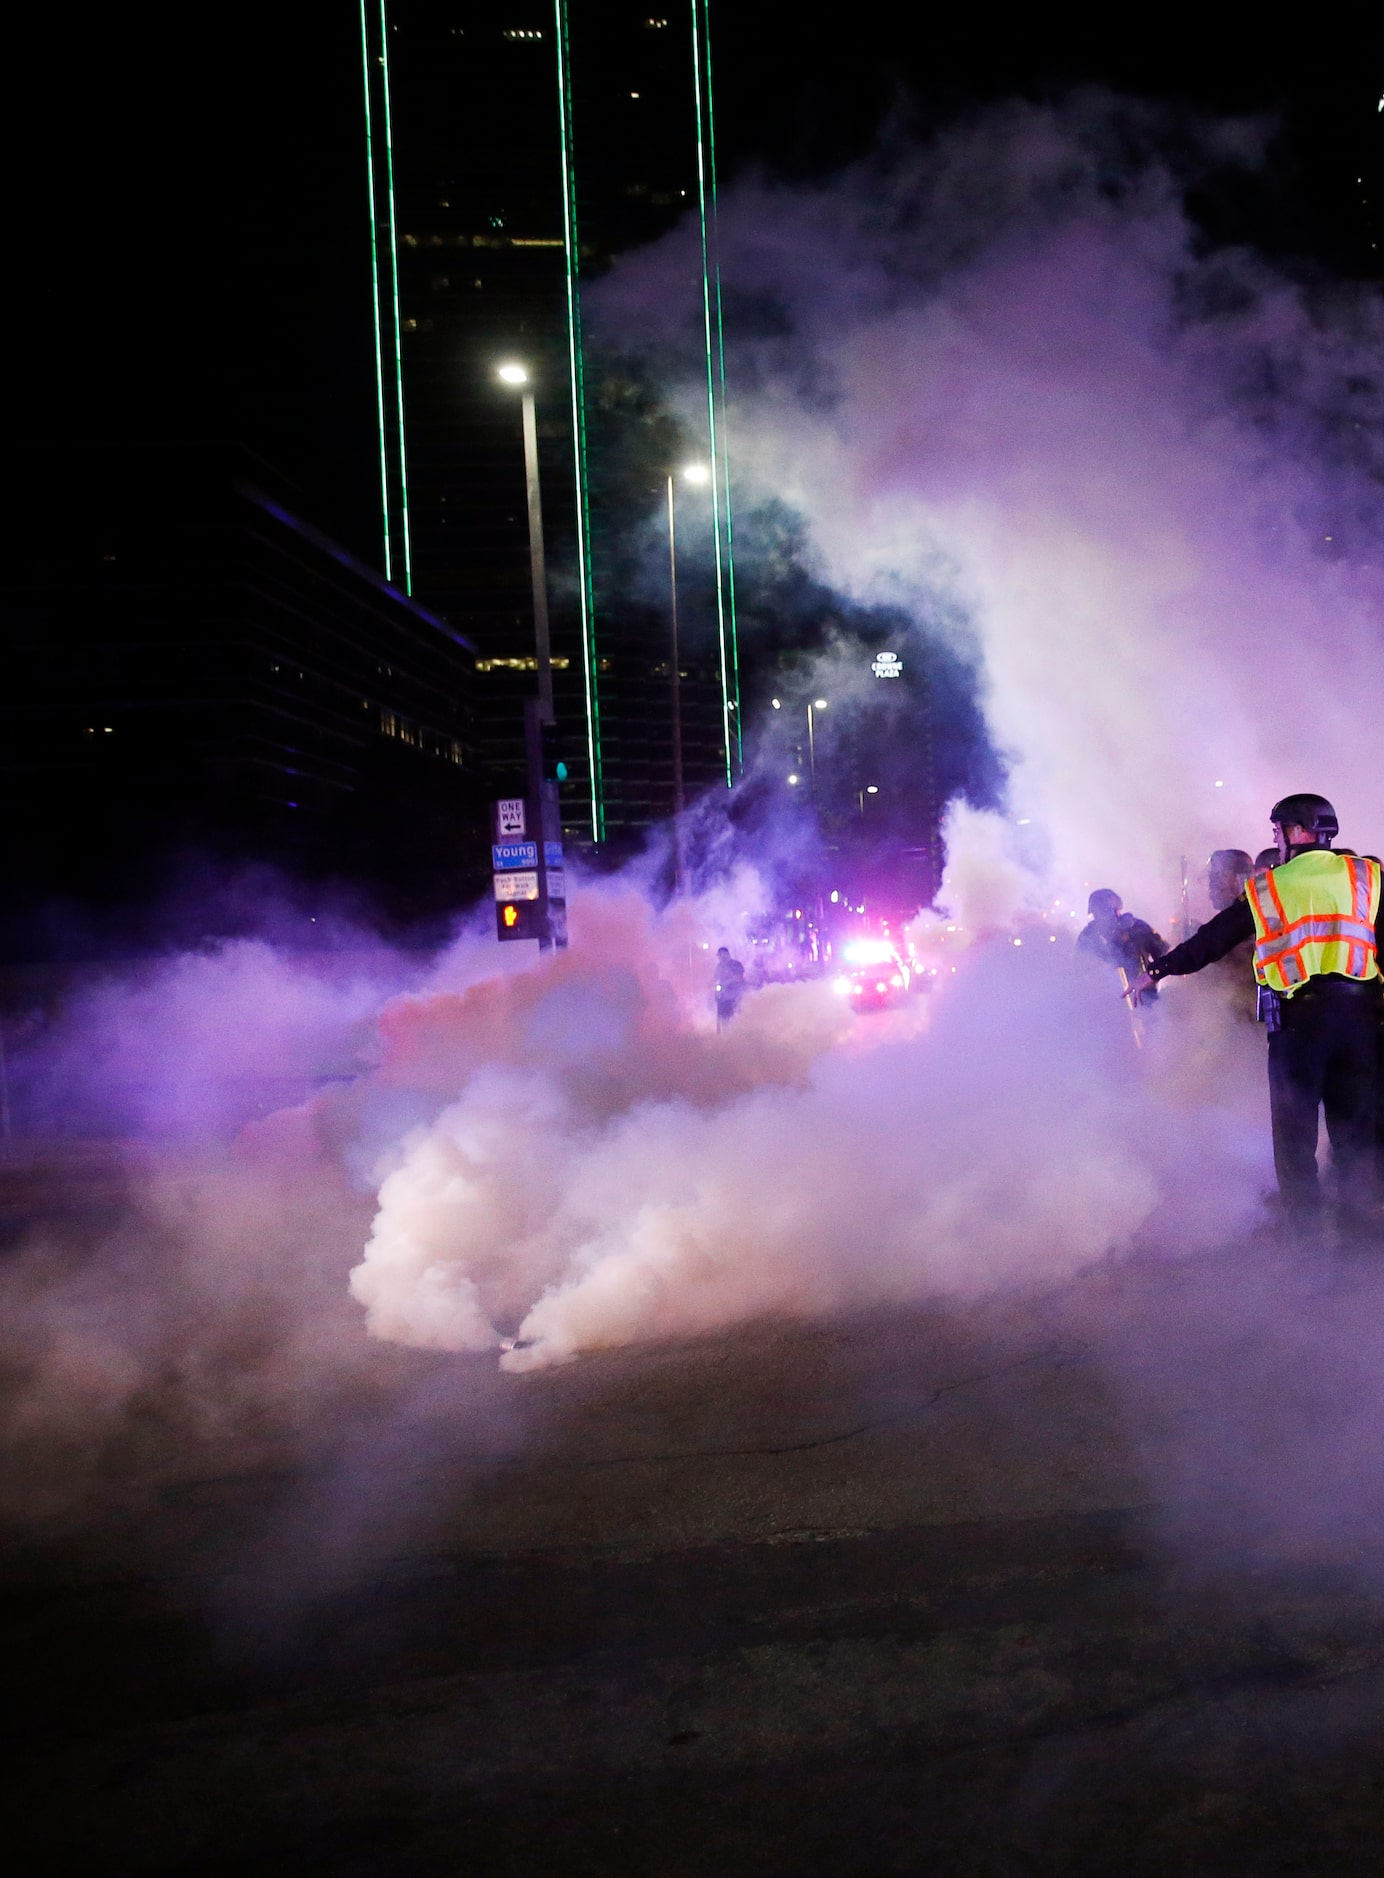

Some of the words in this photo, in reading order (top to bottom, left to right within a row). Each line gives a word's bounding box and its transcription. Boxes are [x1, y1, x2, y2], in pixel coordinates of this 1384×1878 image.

[501, 802, 521, 813] ONE
[502, 813, 521, 821] WAY
[496, 846, 535, 858] Young
